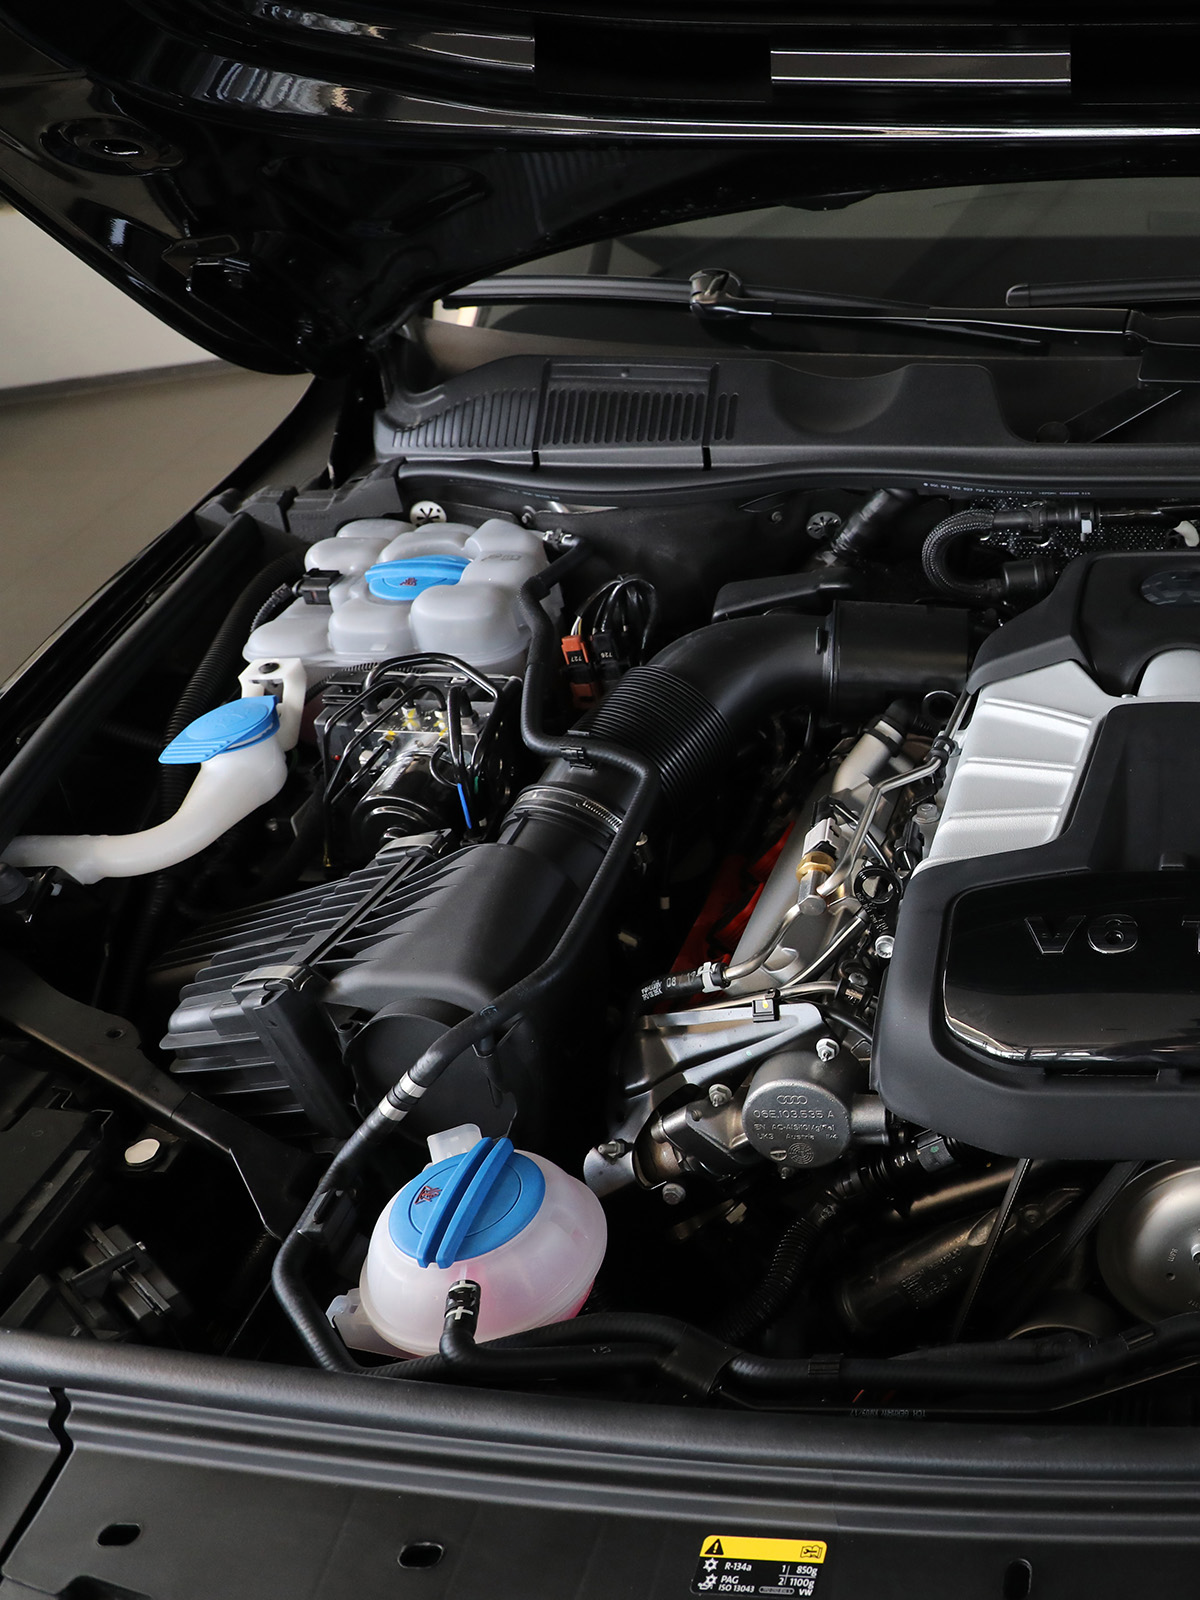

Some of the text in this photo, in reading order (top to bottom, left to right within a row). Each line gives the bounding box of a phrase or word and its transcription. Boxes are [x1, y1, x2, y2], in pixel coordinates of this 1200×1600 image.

[1023, 913, 1139, 955] V6
[666, 976, 677, 988] 08
[827, 1110, 834, 1119] A
[724, 1561, 752, 1572] R-134a
[796, 1565, 818, 1578] 850g
[720, 1575, 739, 1584] PAG
[789, 1577, 815, 1590] 1100g
[718, 1584, 732, 1592] ISO
[733, 1584, 755, 1593] 13043
[798, 1588, 813, 1597] VW
